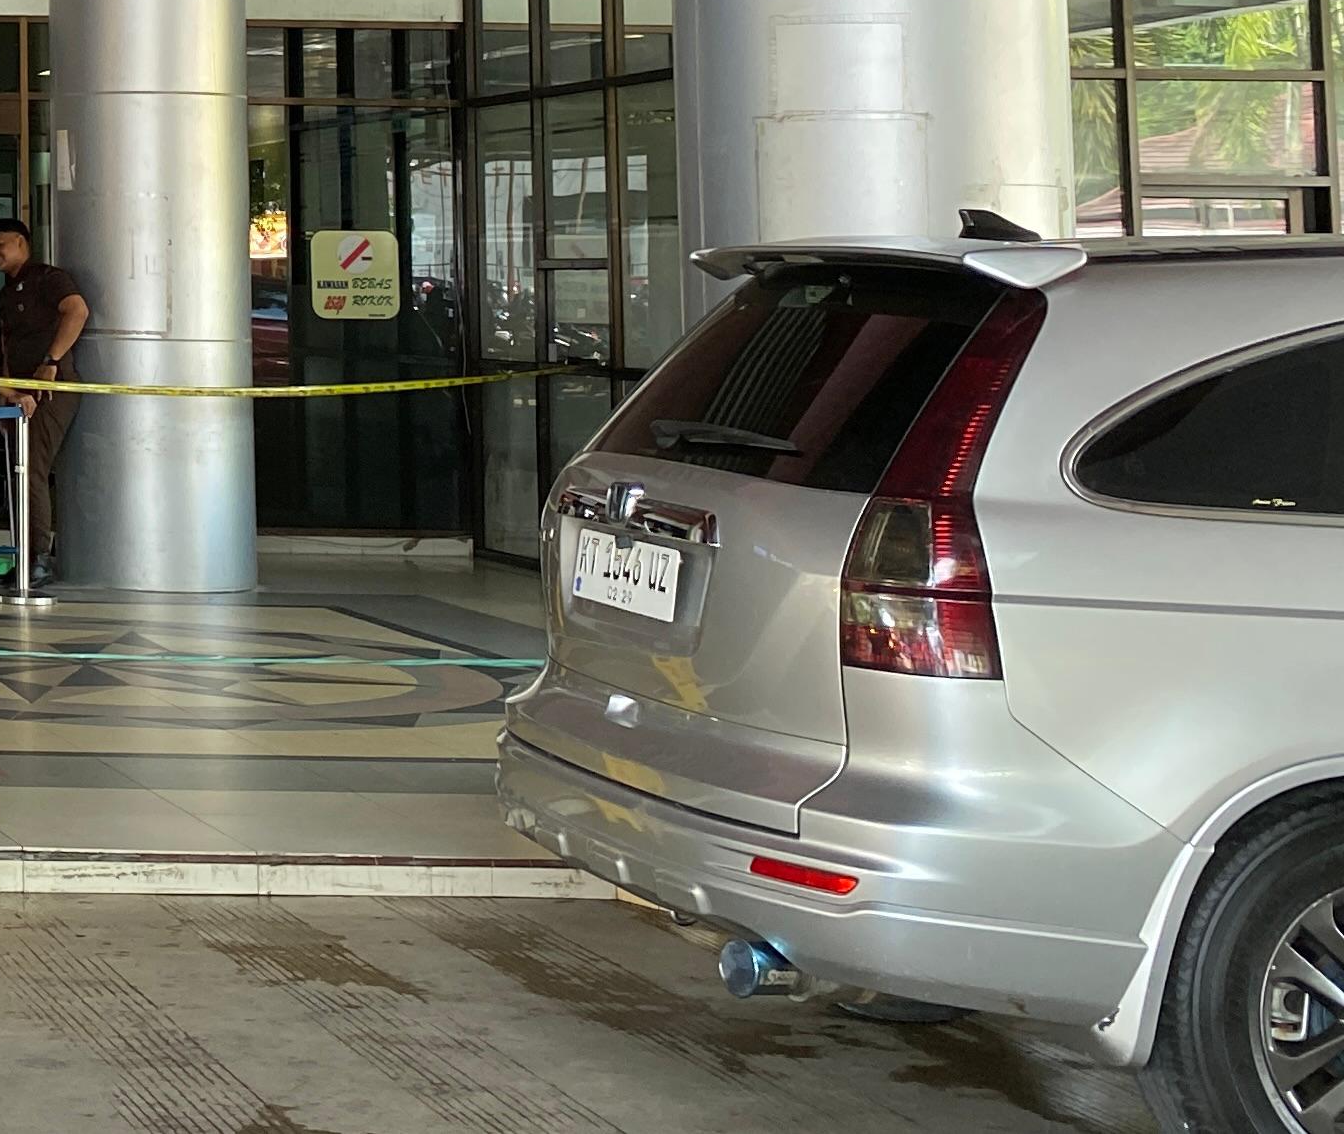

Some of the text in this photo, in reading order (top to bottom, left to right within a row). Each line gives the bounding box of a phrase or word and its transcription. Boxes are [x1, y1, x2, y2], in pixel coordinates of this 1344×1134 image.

[352, 277, 393, 290] BEBAS
[352, 295, 394, 307] ROKOK
[579, 536, 600, 575] KT
[649, 552, 670, 593] UZ
